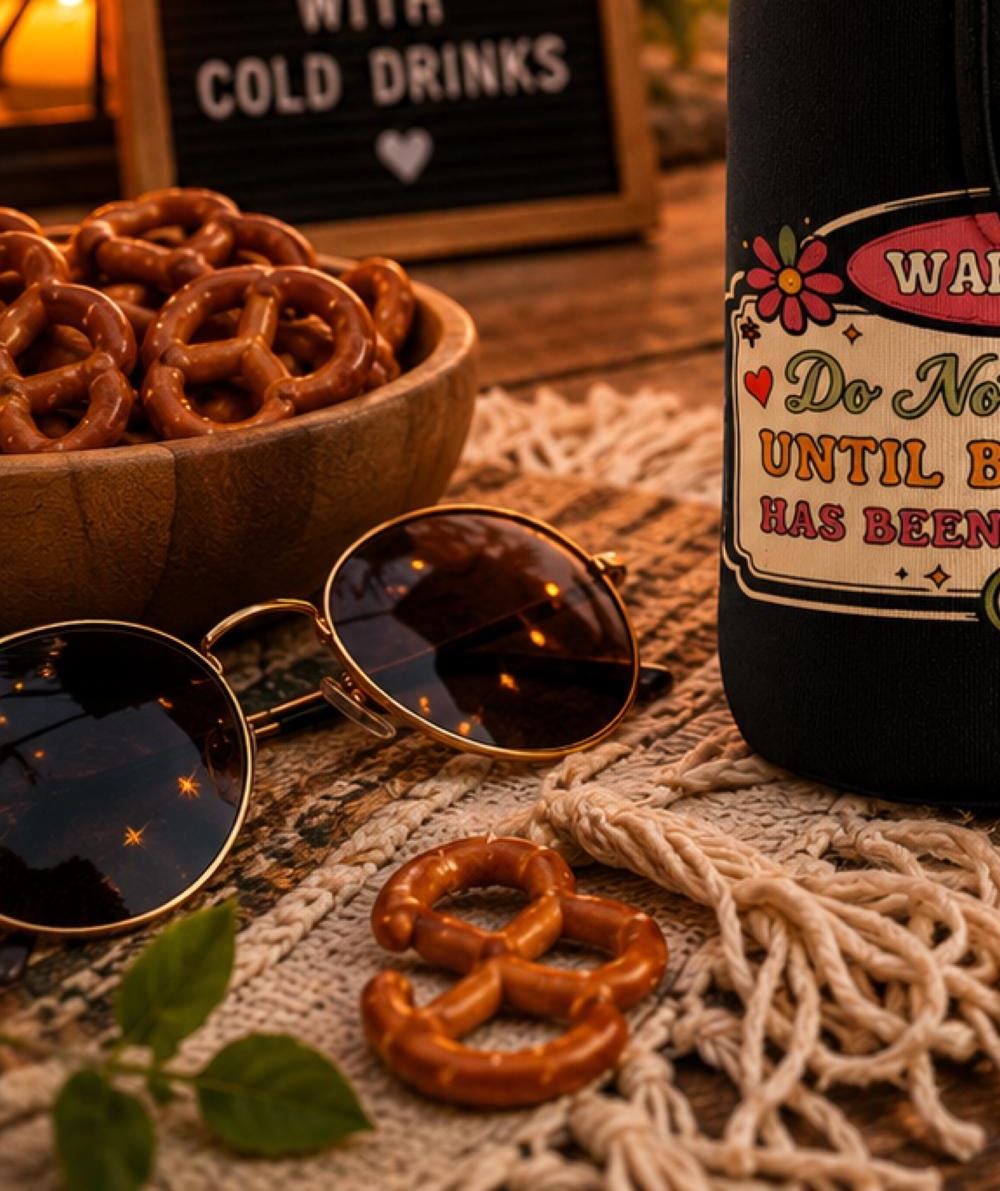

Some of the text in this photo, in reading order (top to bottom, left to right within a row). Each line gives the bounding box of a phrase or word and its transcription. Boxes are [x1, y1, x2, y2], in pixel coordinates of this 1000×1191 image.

[197, 34, 570, 121] COLD DRINKS
[784, 349, 882, 414] Do
[758, 428, 943, 488] UNTIL
[760, 495, 846, 541] HAS
